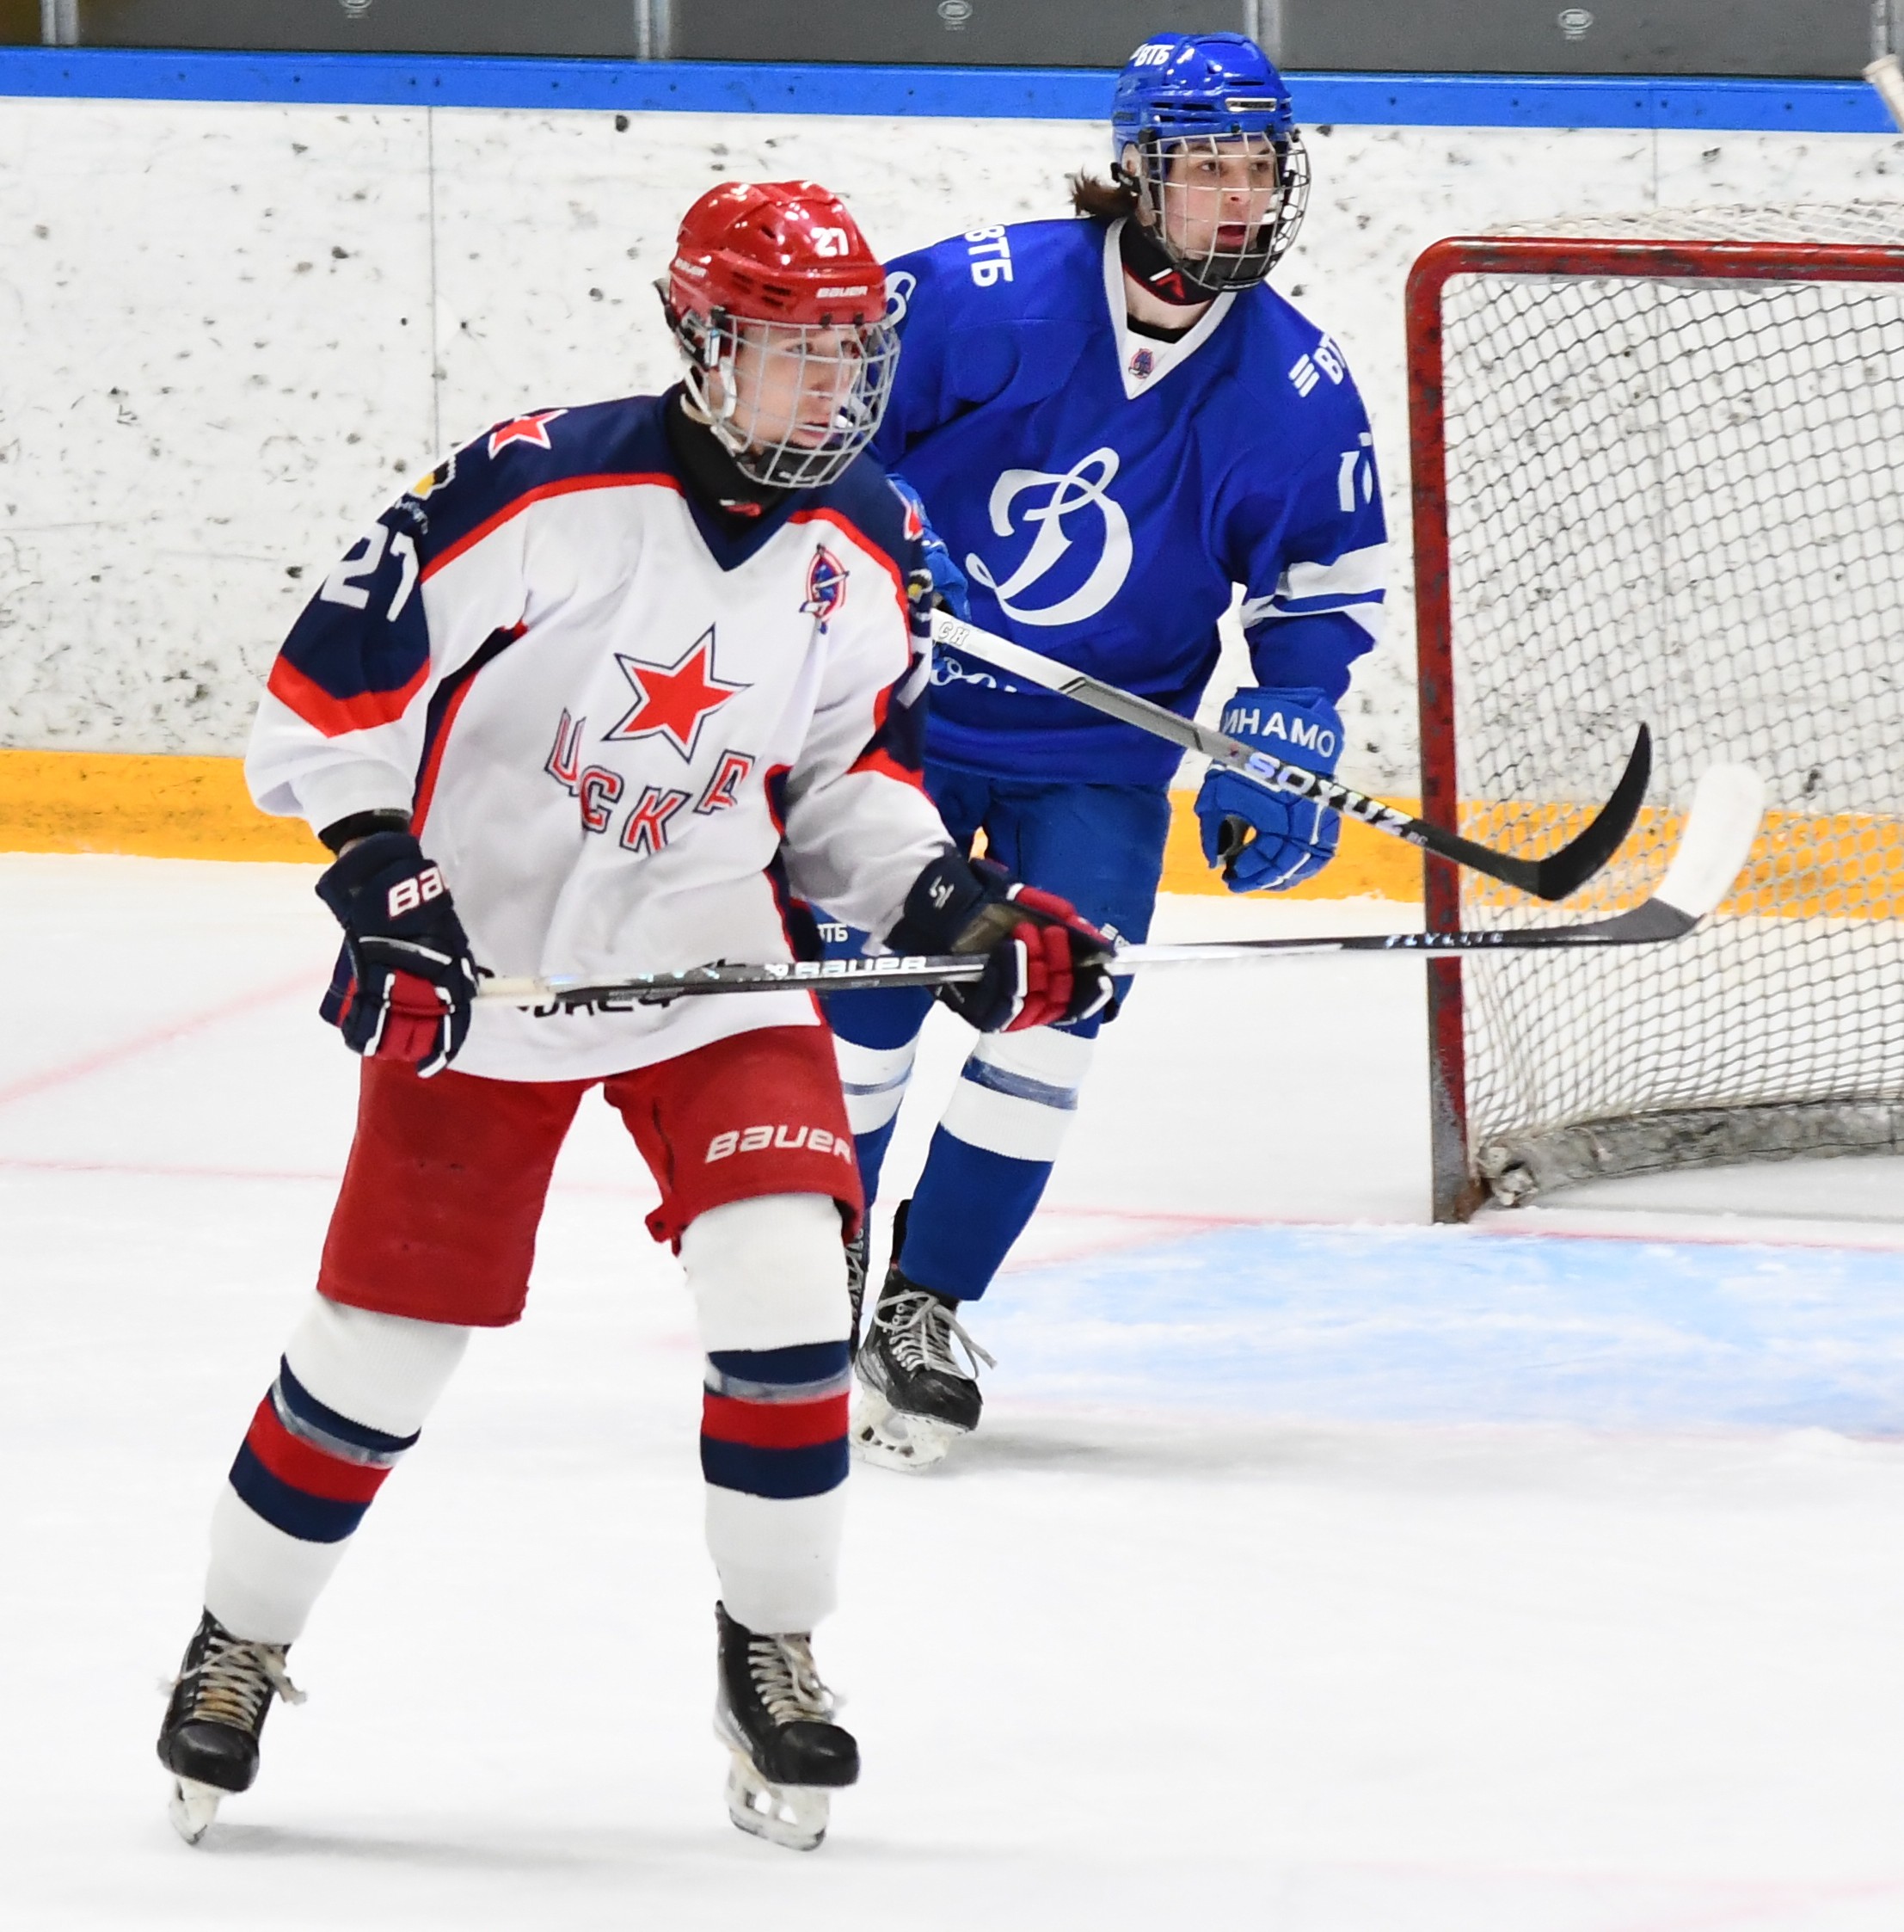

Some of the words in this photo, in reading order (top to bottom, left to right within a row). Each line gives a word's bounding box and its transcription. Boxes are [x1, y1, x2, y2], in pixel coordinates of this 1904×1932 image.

[810, 226, 850, 258] 27
[964, 225, 1014, 287] ВТБ
[1312, 332, 1347, 385] ВТ
[319, 520, 420, 623] 27
[1245, 751, 1414, 838] SOYUZ
[795, 955, 927, 979] BAUER
[704, 1124, 853, 1165] BAUER
